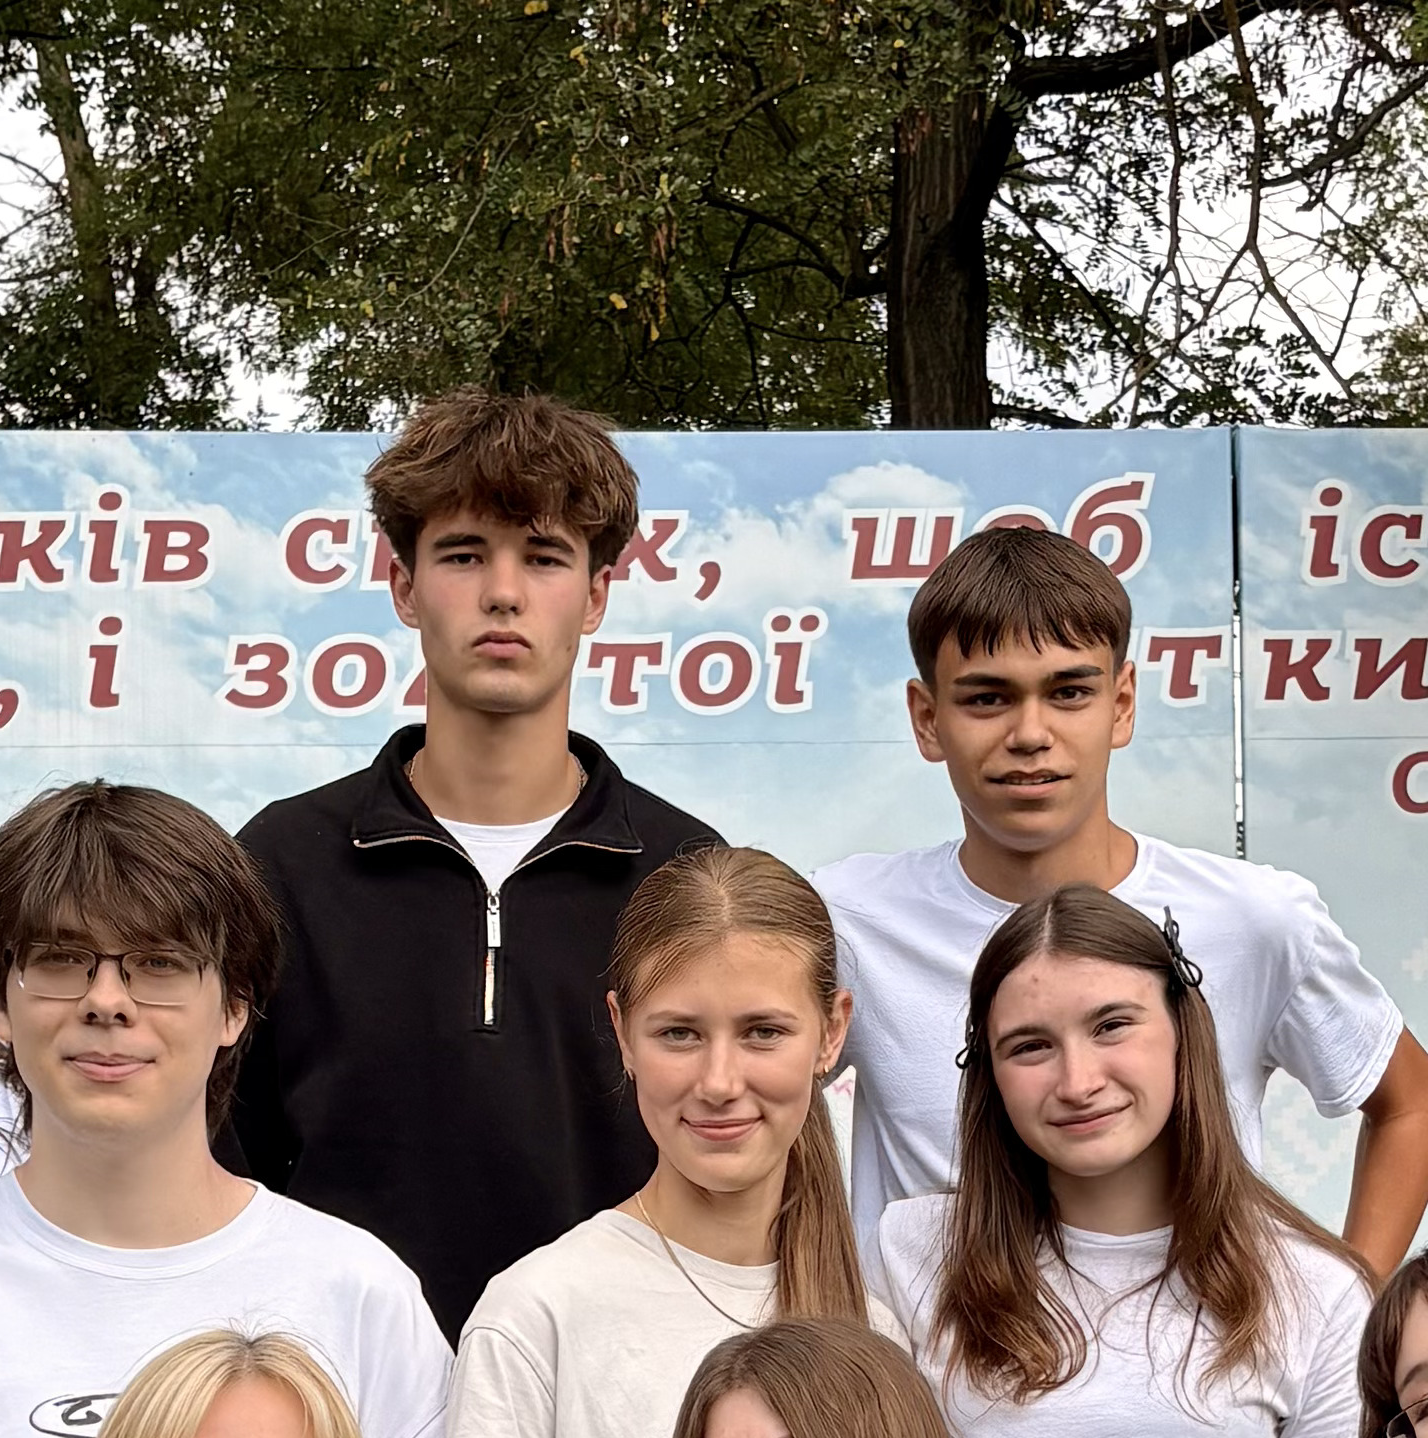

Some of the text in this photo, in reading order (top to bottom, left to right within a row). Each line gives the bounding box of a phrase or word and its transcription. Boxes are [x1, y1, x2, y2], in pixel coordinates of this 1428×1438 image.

[851, 482, 1145, 579] щб
[89, 617, 121, 709] і
[226, 615, 819, 709] зотої
